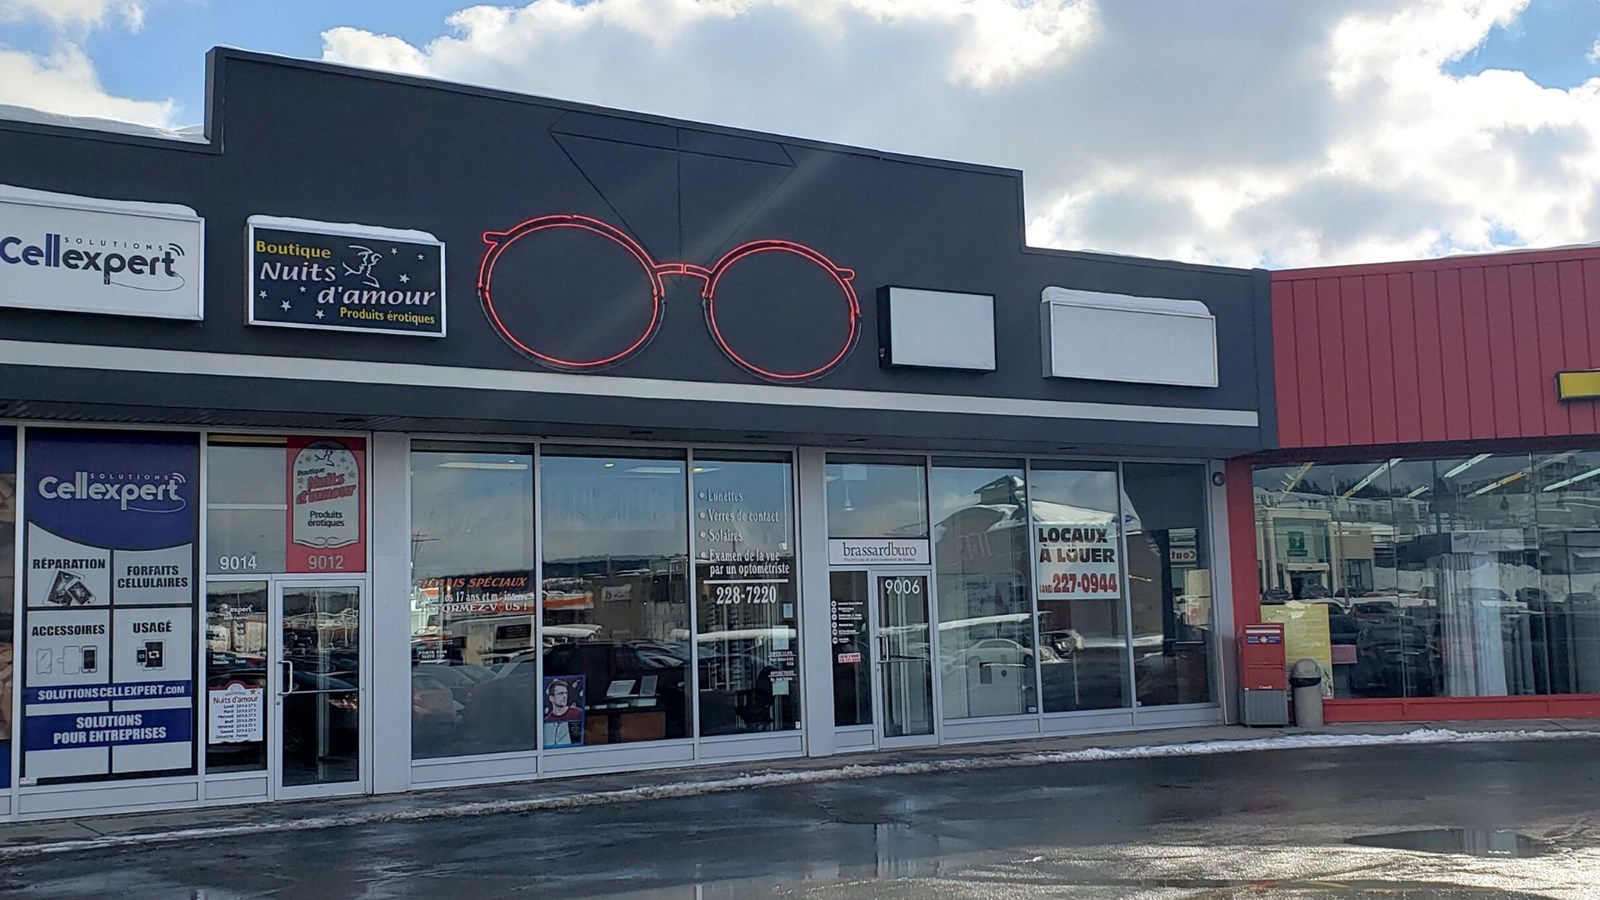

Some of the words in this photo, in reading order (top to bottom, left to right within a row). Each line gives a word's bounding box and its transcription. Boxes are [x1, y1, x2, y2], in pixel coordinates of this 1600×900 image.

[64, 236, 164, 252] SOLUTIONS
[256, 240, 331, 260] Boutique
[0, 233, 177, 285] Cellexpert
[260, 261, 336, 282] Nuits
[318, 287, 436, 306] d'amour
[340, 307, 385, 321] Produits
[387, 310, 436, 326] érotiques
[90, 473, 169, 481] SOLUTIONS
[297, 467, 325, 477] Boutique
[307, 473, 346, 490] Nuits
[38, 472, 180, 511] Cellexpert
[708, 488, 744, 502] Lunettes
[310, 510, 343, 519] Produits
[708, 508, 735, 522] Verres
[736, 510, 747, 521] de
[748, 510, 779, 522] contact
[307, 518, 345, 528] érotiques
[708, 528, 743, 542] Solaires
[1038, 527, 1108, 543] LOCAUX
[709, 549, 742, 562] Examen
[744, 549, 754, 561] de
[756, 549, 764, 561] la
[766, 551, 780, 561] vue
[842, 542, 917, 556] brassardburo
[1039, 544, 1052, 563] À
[1057, 547, 1116, 563] LOUER
[33, 557, 106, 570] RÉPARATION
[219, 555, 257, 570] 9014
[308, 555, 344, 570] 9012
[710, 564, 724, 577] par
[726, 564, 736, 575] un
[738, 562, 790, 577] optométriste
[127, 565, 179, 576] FORFAITS
[117, 577, 188, 588] CELLULAIRES
[468, 575, 528, 588] SPÉCIAUX
[884, 579, 920, 594] 9006
[456, 592, 465, 602] 17
[466, 592, 480, 602] ans
[481, 592, 489, 601] et
[716, 586, 777, 604] 228-7220
[32, 624, 105, 637] ACCESSOIRES
[132, 620, 172, 634] USAGÉ
[38, 685, 185, 701] SOLUTIONSCELLEXPERT.COM
[76, 714, 142, 729] SOLUTIONS
[53, 731, 87, 745] POUR
[89, 727, 166, 743] ENTREPRISES
